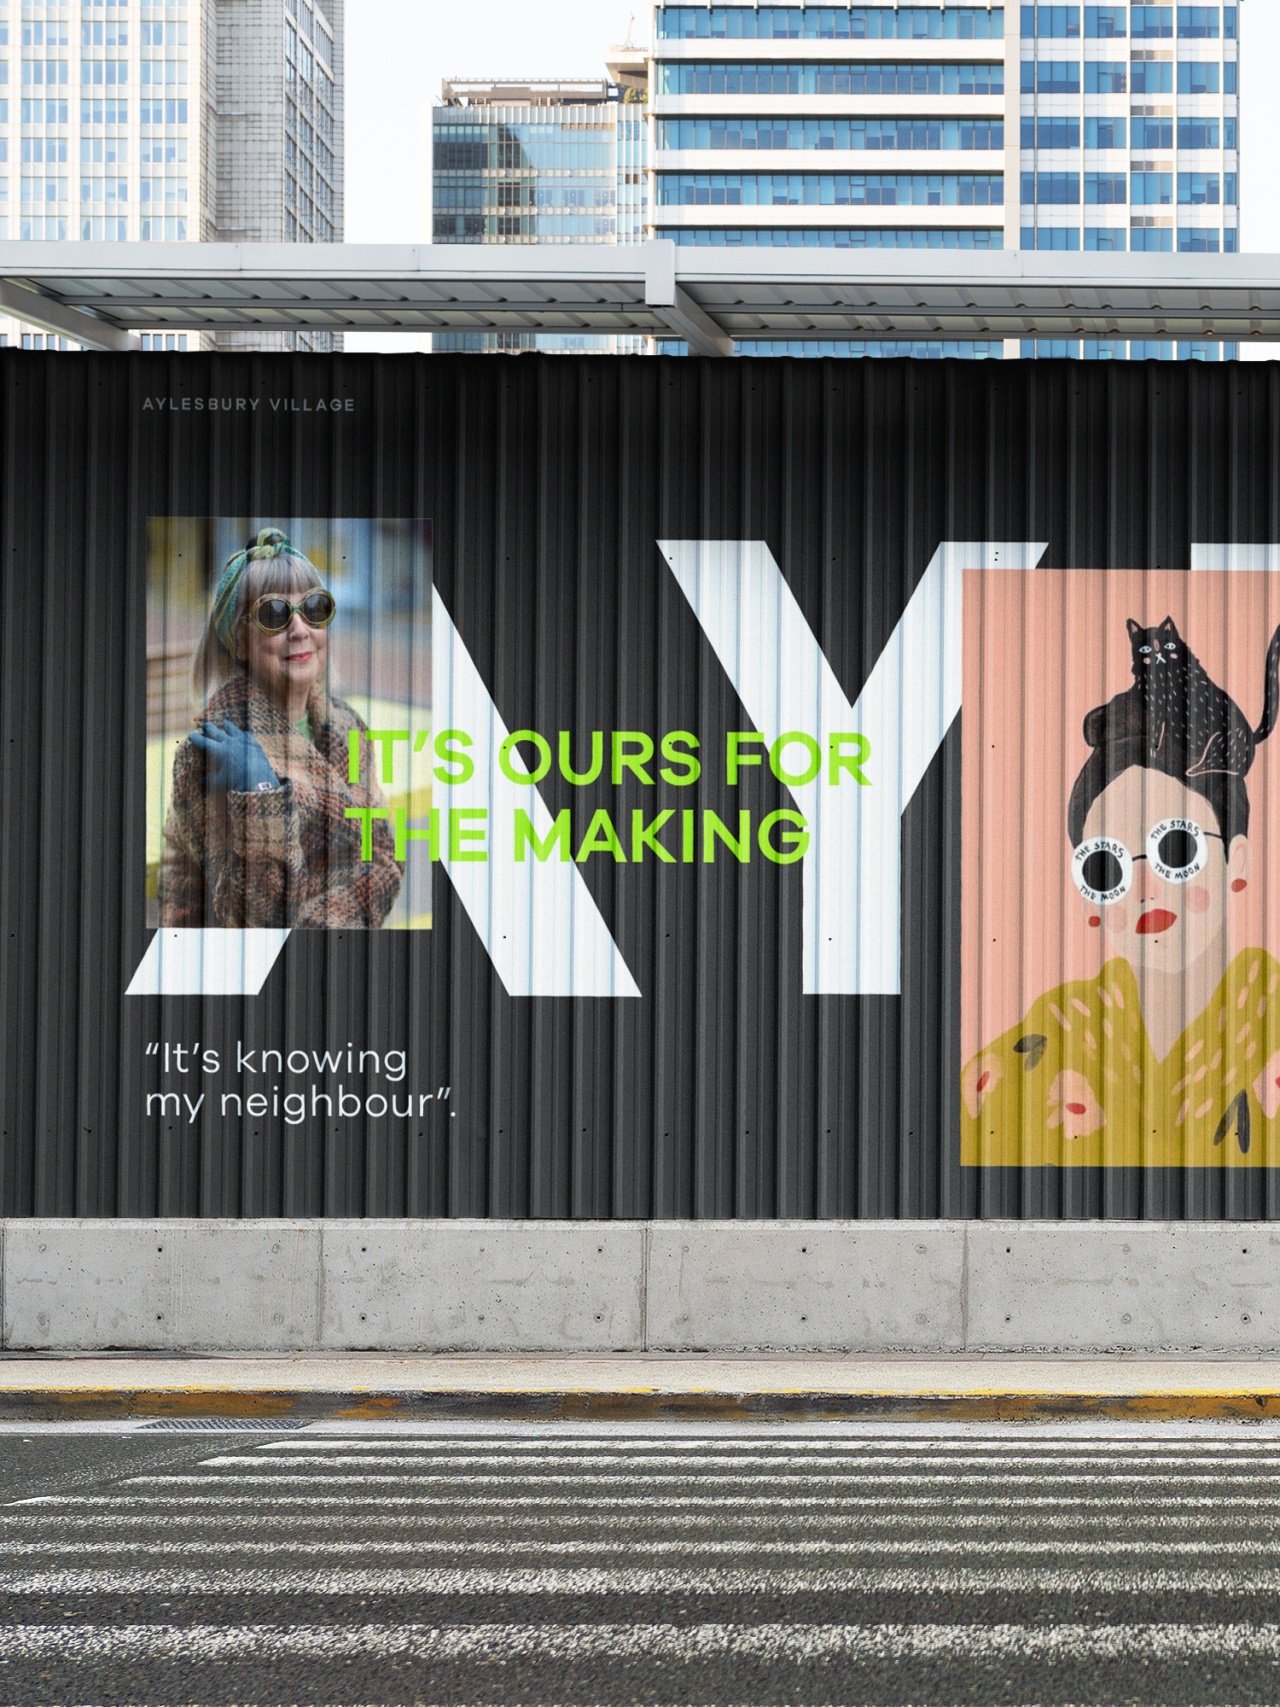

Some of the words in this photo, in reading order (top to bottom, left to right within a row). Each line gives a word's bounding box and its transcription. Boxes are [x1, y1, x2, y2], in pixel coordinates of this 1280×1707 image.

[142, 397, 260, 411] AYLESBURY
[269, 398, 355, 412] VILLAGE
[347, 729, 475, 785] IT'S
[498, 729, 702, 787] OURS
[726, 730, 873, 787] FOR
[344, 807, 488, 863] THE
[513, 808, 811, 866] MAKING
[1150, 823, 1167, 840] THE
[1170, 819, 1200, 837] STARS
[1075, 845, 1091, 861] THE
[1094, 841, 1125, 859] STARS
[1154, 862, 1171, 879] THE
[1174, 862, 1200, 880] MOON
[1079, 885, 1097, 900] THE
[1100, 885, 1126, 902] MOON
[236, 1040, 407, 1082] knowing
[146, 1092, 206, 1124] my
